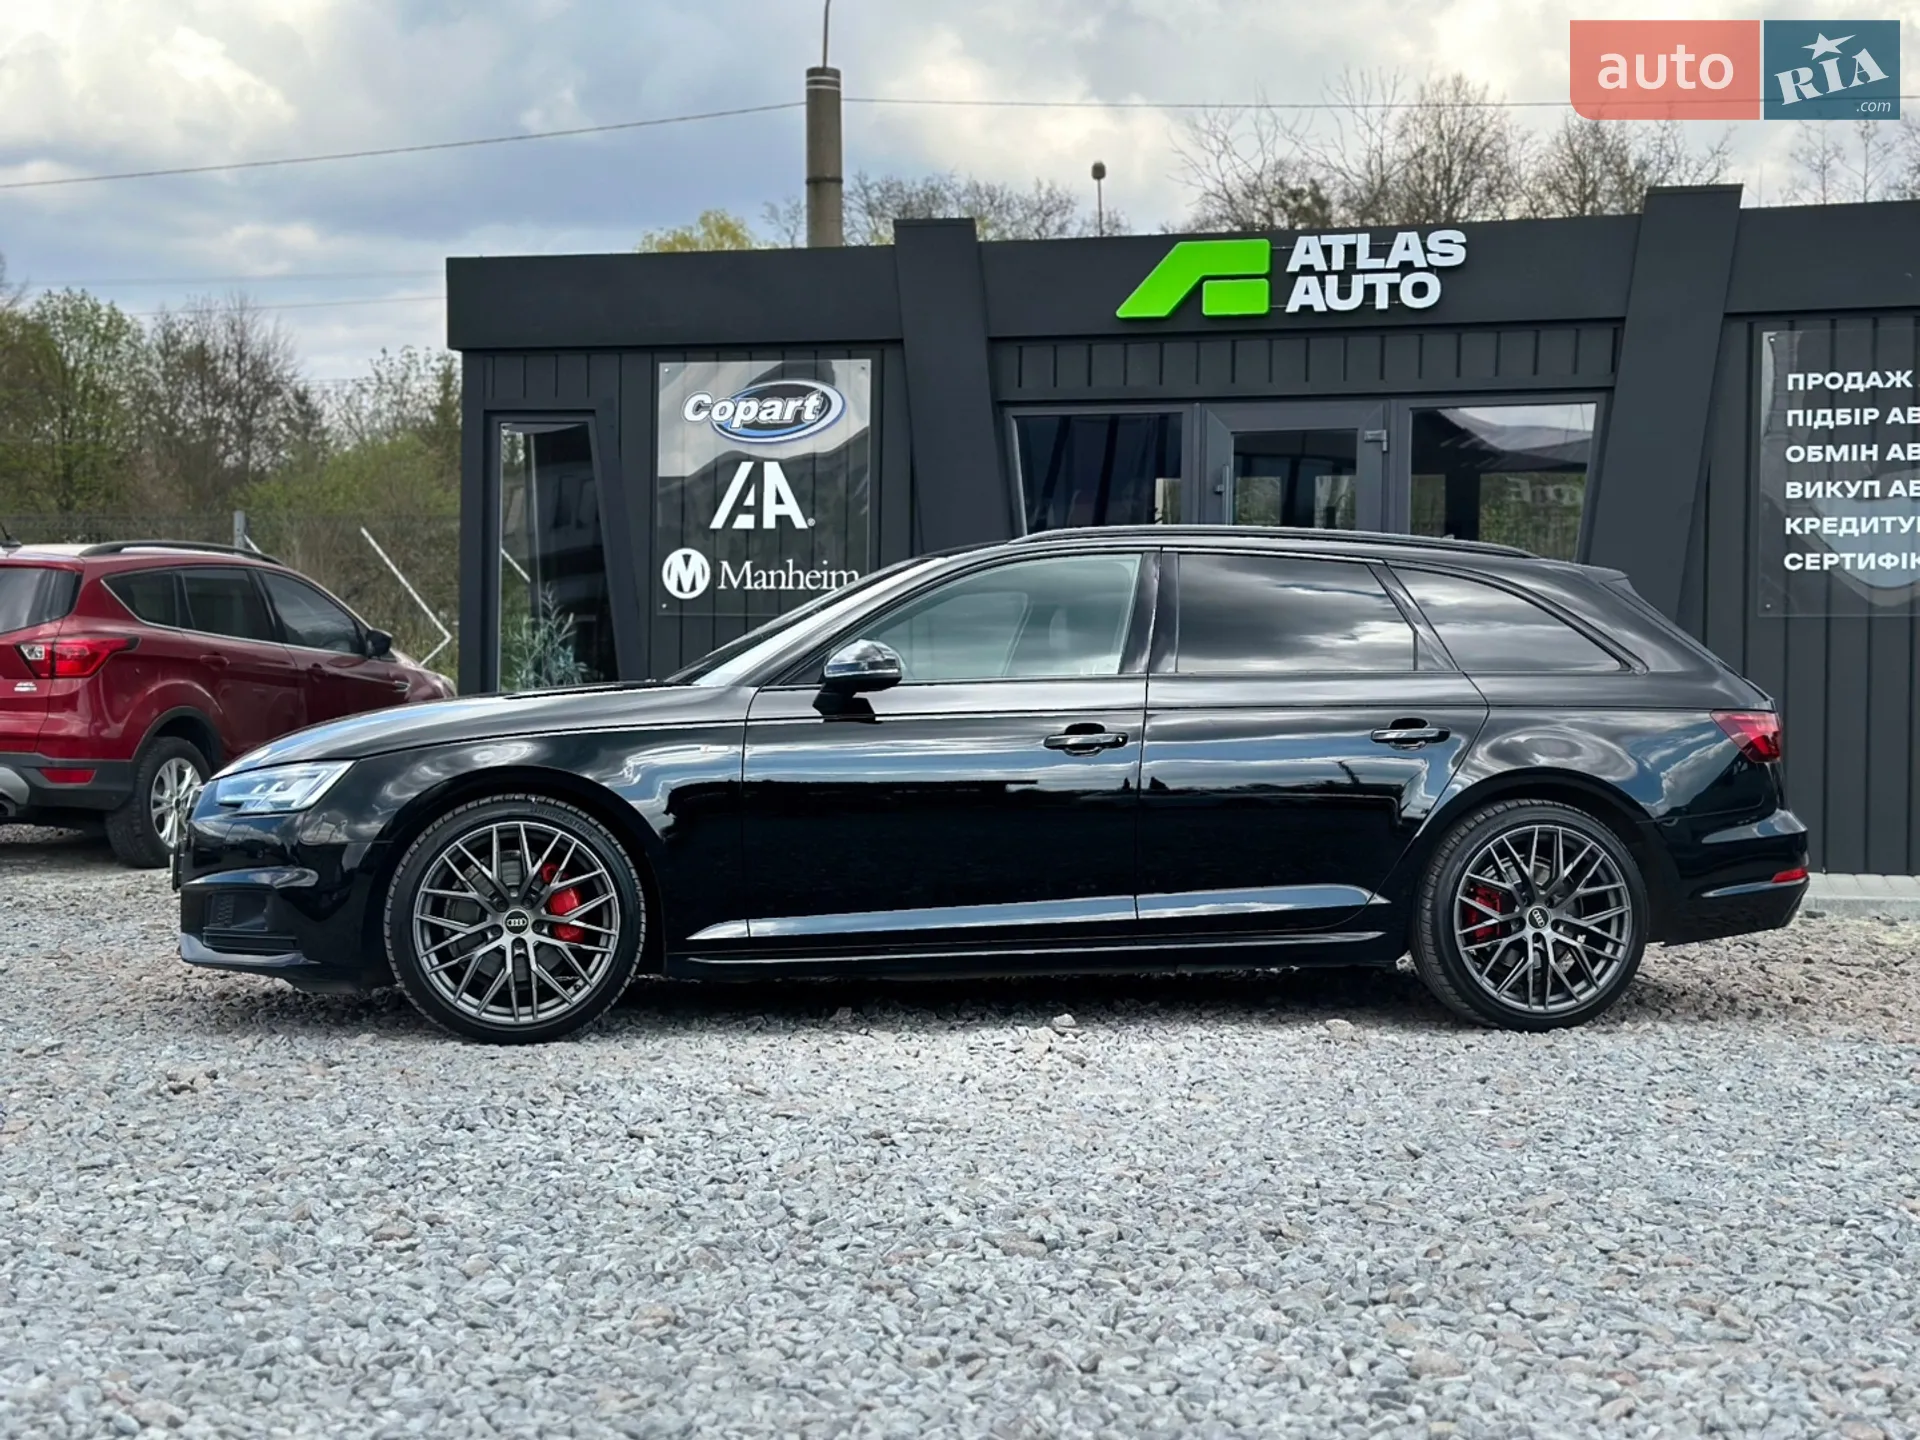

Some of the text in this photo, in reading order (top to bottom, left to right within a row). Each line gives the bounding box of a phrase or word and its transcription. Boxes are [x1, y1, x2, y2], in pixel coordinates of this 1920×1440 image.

[1285, 229, 1467, 272] ATLAS
[1285, 271, 1442, 313] AUTO
[1787, 370, 1914, 393] ПРОДАЖ
[682, 390, 824, 430] Copart
[1786, 407, 1880, 430] ПІДБІР
[1785, 444, 1879, 463] ОБМІН
[1785, 480, 1881, 499] ВИКУП
[1784, 516, 1920, 538] КРЕДИТУ
[717, 559, 859, 590] Manheim
